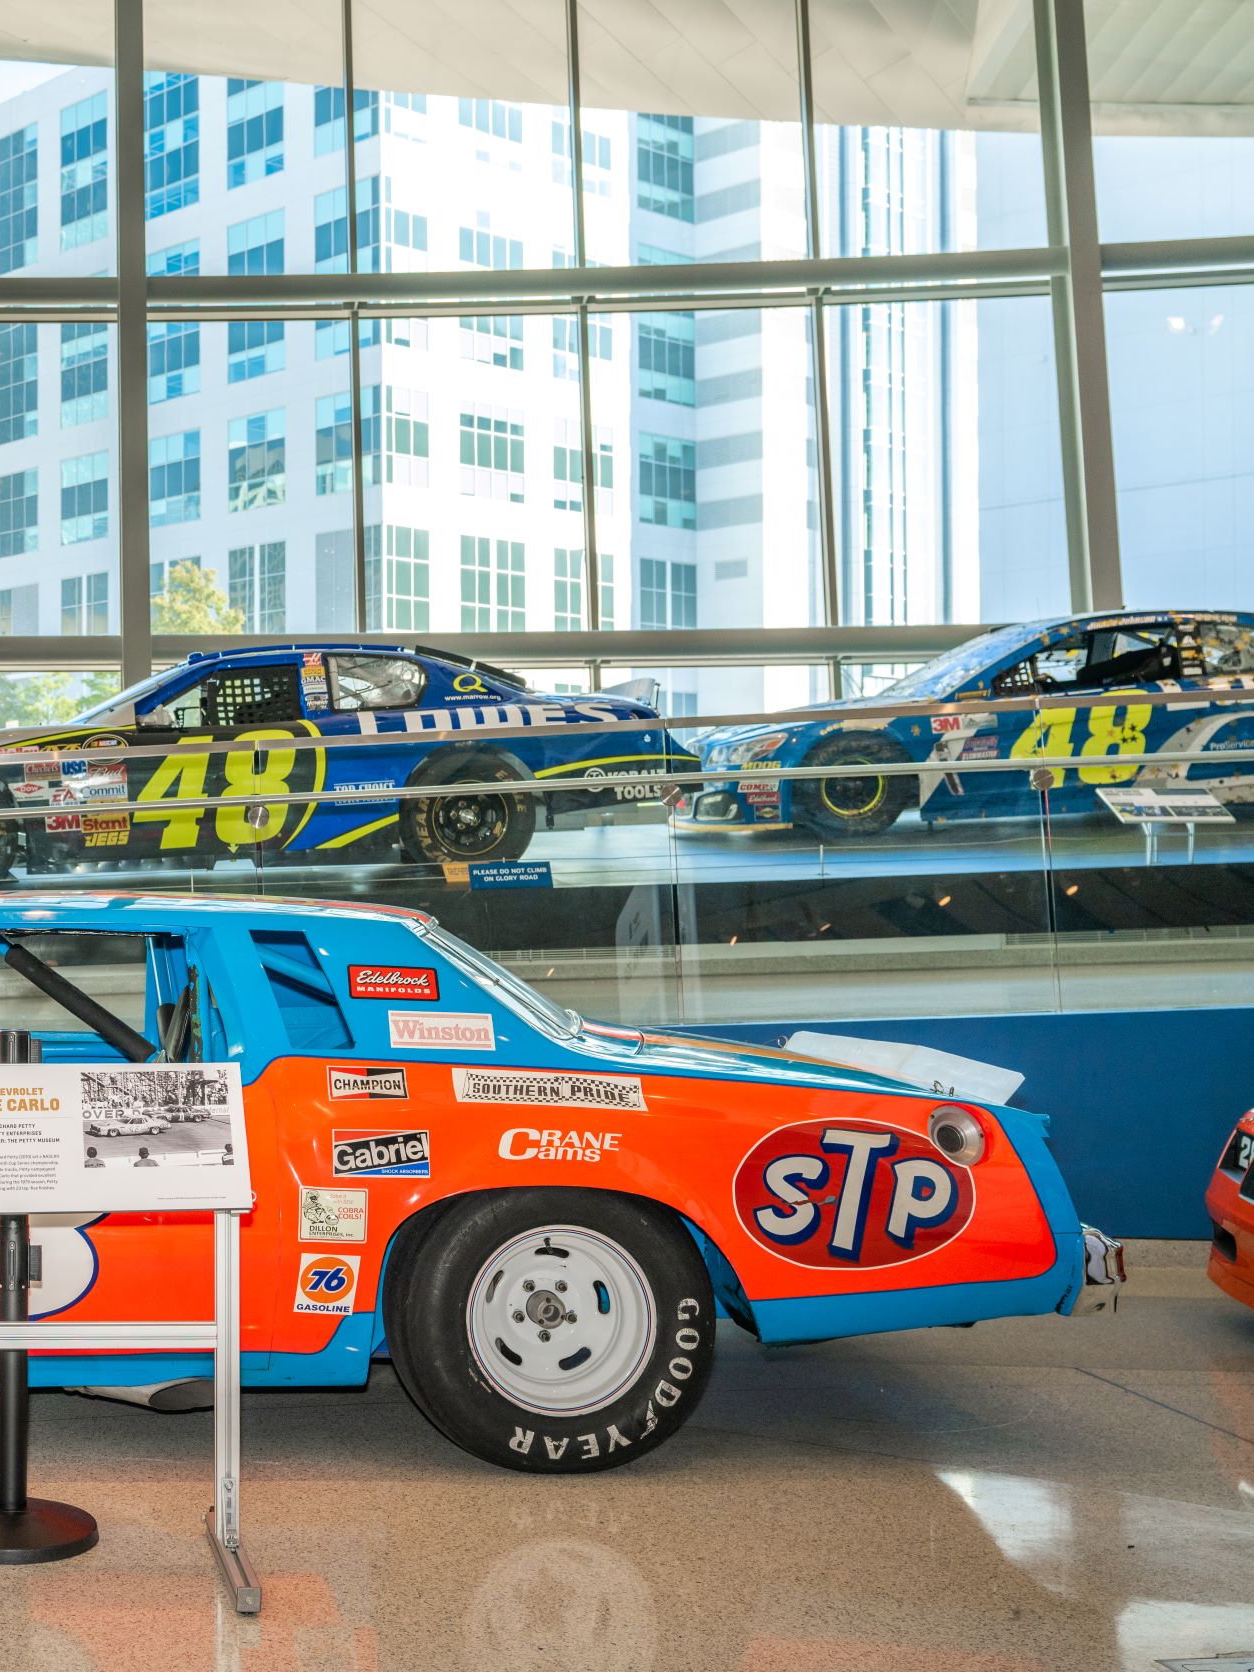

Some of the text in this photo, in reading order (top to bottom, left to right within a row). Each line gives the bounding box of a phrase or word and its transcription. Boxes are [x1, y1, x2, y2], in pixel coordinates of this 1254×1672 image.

[933, 716, 961, 733] 3M
[1008, 690, 1153, 790] 48
[79, 785, 126, 799] Commit
[132, 729, 297, 850] 48
[614, 785, 662, 801] TOOLS
[47, 815, 81, 831] 3M
[84, 832, 128, 848] JEGS
[472, 868, 498, 876] PLEASE
[526, 866, 547, 874] CLIMB
[356, 970, 430, 987] Edelbrock
[356, 985, 431, 995] MANIFOLDS
[390, 1019, 492, 1042] Winston
[333, 1078, 402, 1092] CHAMPION
[472, 1082, 632, 1103] SOUTHERN PRIDE
[6, 1097, 61, 1112] CARLO
[334, 1133, 429, 1171] Gabriel
[752, 1128, 959, 1264] STP
[305, 1265, 348, 1293] 76
[296, 1303, 351, 1313] GASOLINE
